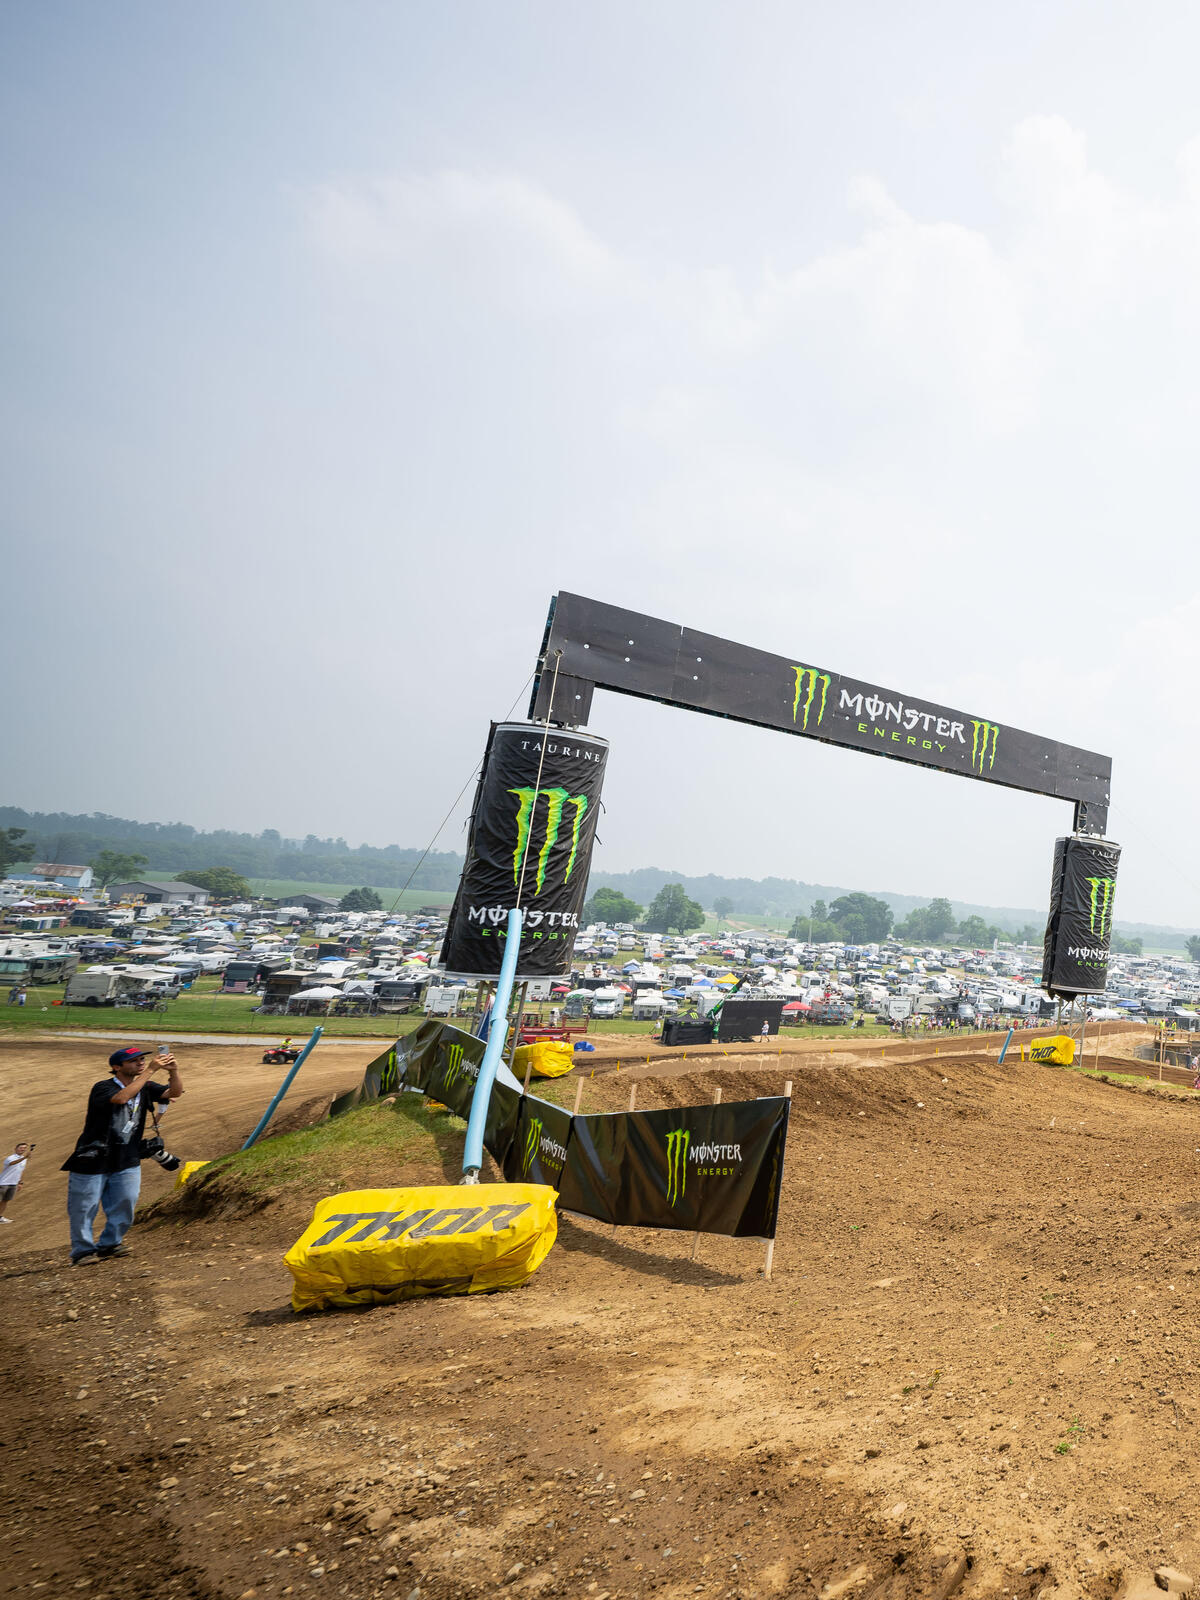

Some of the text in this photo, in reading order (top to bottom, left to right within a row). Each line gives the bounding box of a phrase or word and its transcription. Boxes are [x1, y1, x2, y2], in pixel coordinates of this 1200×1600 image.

[839, 689, 967, 744] MONSTER
[857, 722, 947, 753] ENERGY
[521, 740, 600, 763] TAURINE
[540, 1136, 568, 1162] MONSTE
[689, 1141, 743, 1165] MONSTER
[697, 1167, 736, 1176] ENERGY
[310, 1202, 534, 1248] THOR
